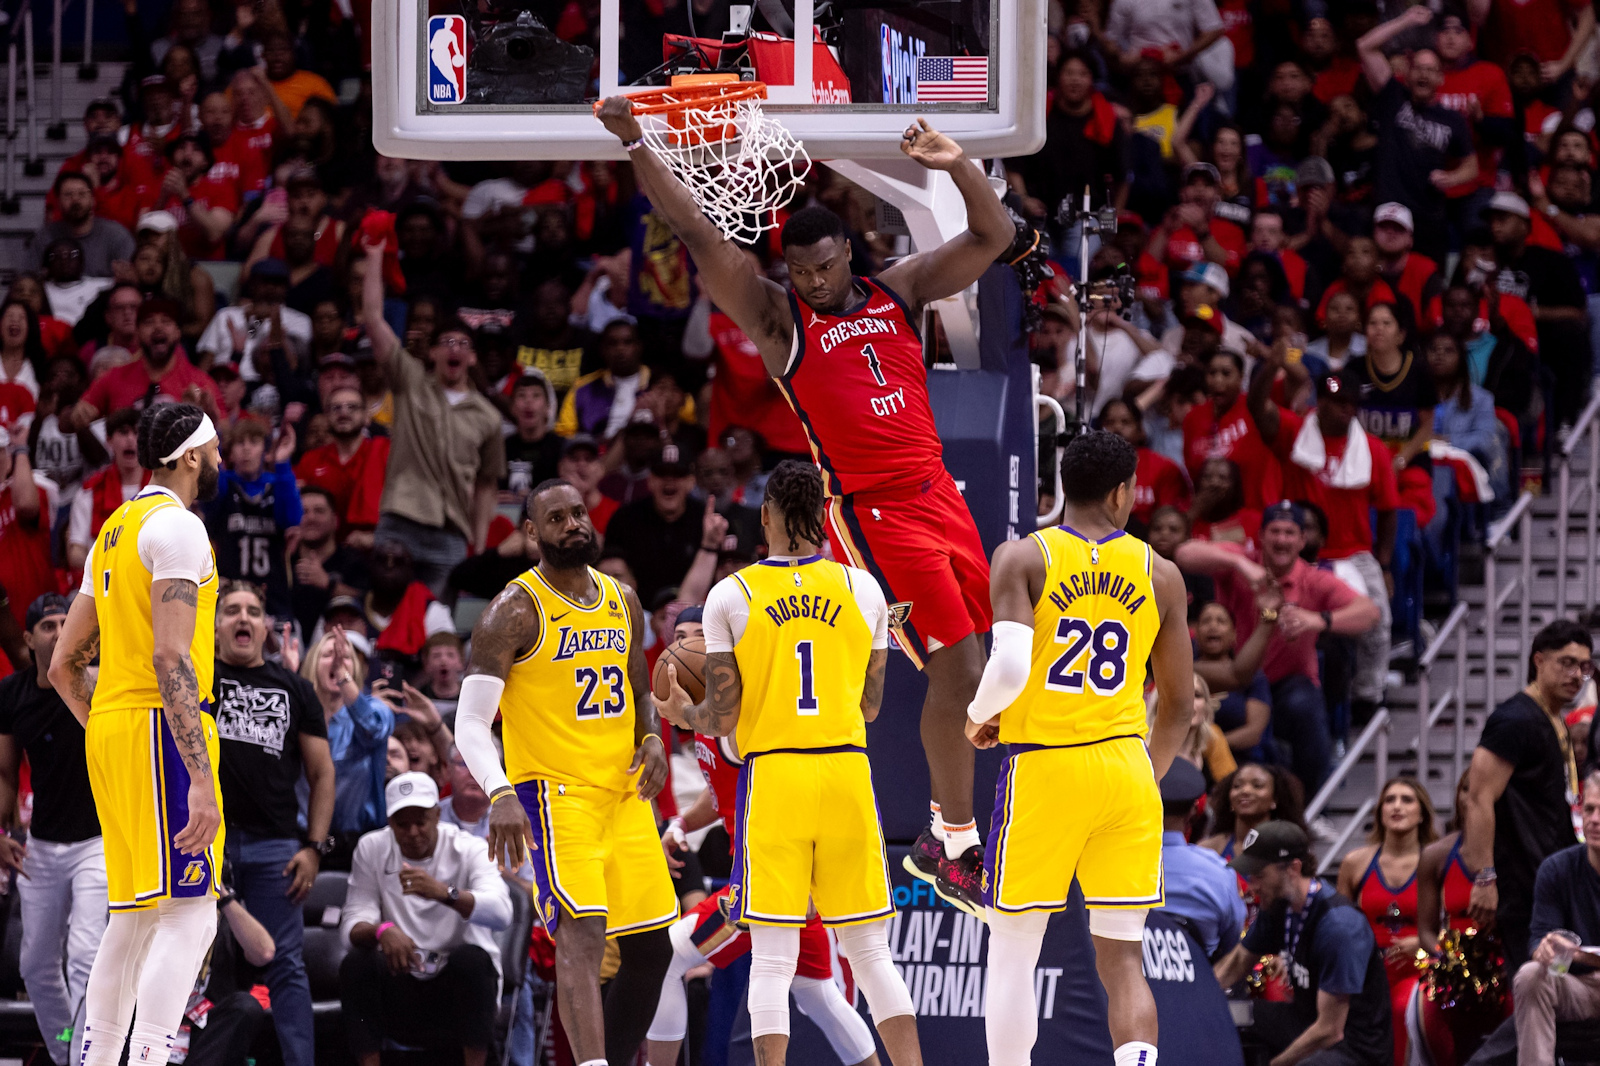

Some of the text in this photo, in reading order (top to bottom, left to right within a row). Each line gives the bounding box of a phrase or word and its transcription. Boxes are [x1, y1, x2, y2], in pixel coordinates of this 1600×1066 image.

[433, 84, 452, 99] NBA
[811, 81, 829, 104] tate
[820, 317, 898, 354] CRESCENT
[860, 343, 887, 387] 1
[870, 387, 906, 416] CITY
[238, 535, 270, 576] 15
[765, 594, 842, 628] RUSSELL
[1049, 571, 1146, 615] HACHIMURA
[551, 626, 627, 662] LAKERS
[1044, 616, 1130, 697] 28
[574, 665, 627, 721] 23
[795, 640, 819, 715] 1
[893, 879, 936, 907] oFi
[887, 910, 984, 964] LAY-IN
